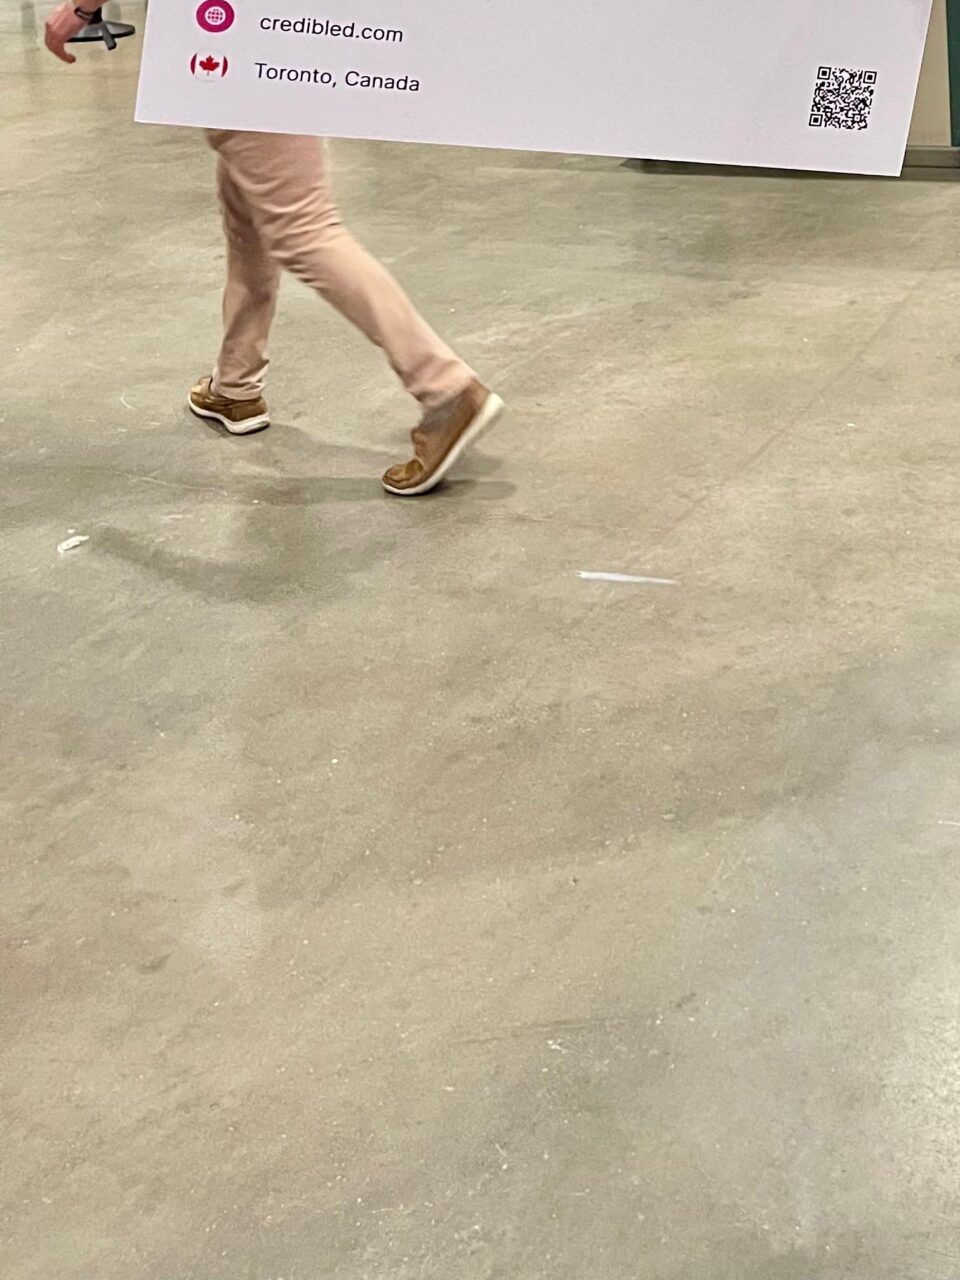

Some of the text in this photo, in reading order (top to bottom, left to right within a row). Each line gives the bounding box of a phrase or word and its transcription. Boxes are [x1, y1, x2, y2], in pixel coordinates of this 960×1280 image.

[260, 16, 403, 43] credibled.com
[254, 62, 421, 92] Toronto, Canada
